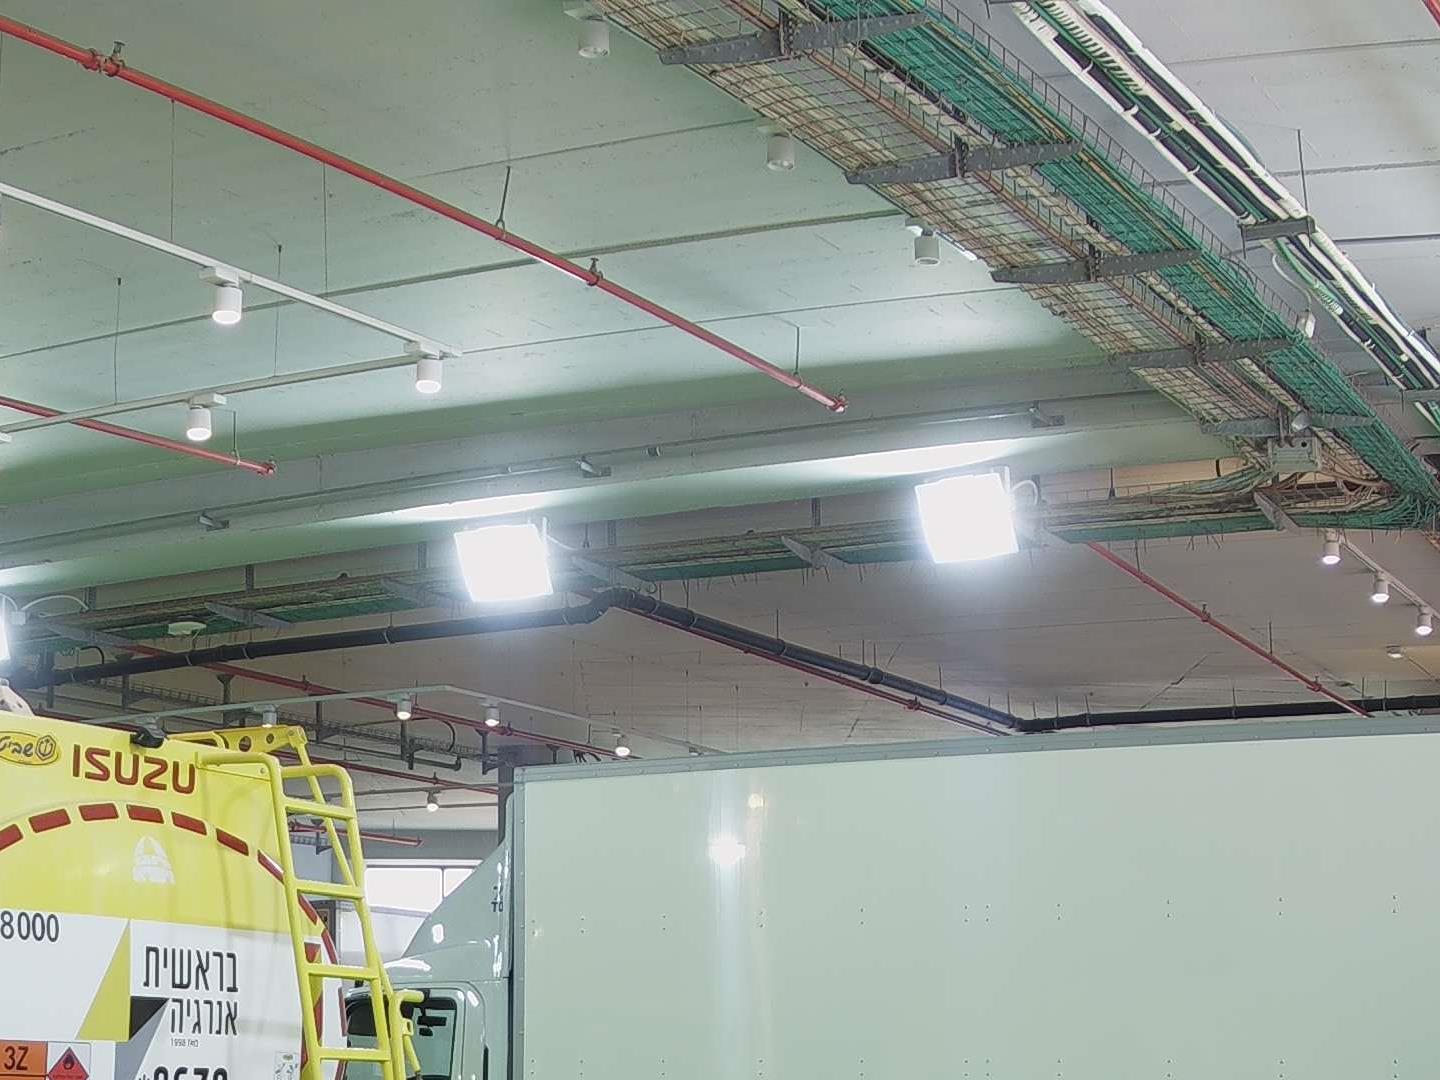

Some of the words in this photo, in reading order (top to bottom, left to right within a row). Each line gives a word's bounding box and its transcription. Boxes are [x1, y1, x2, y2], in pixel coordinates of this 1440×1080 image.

[72, 744, 196, 794] ISUZU
[0, 910, 60, 943] 8000
[143, 946, 239, 993] בראשית
[171, 999, 238, 1036] אנרגיה
[4, 1046, 28, 1071] 3Z
